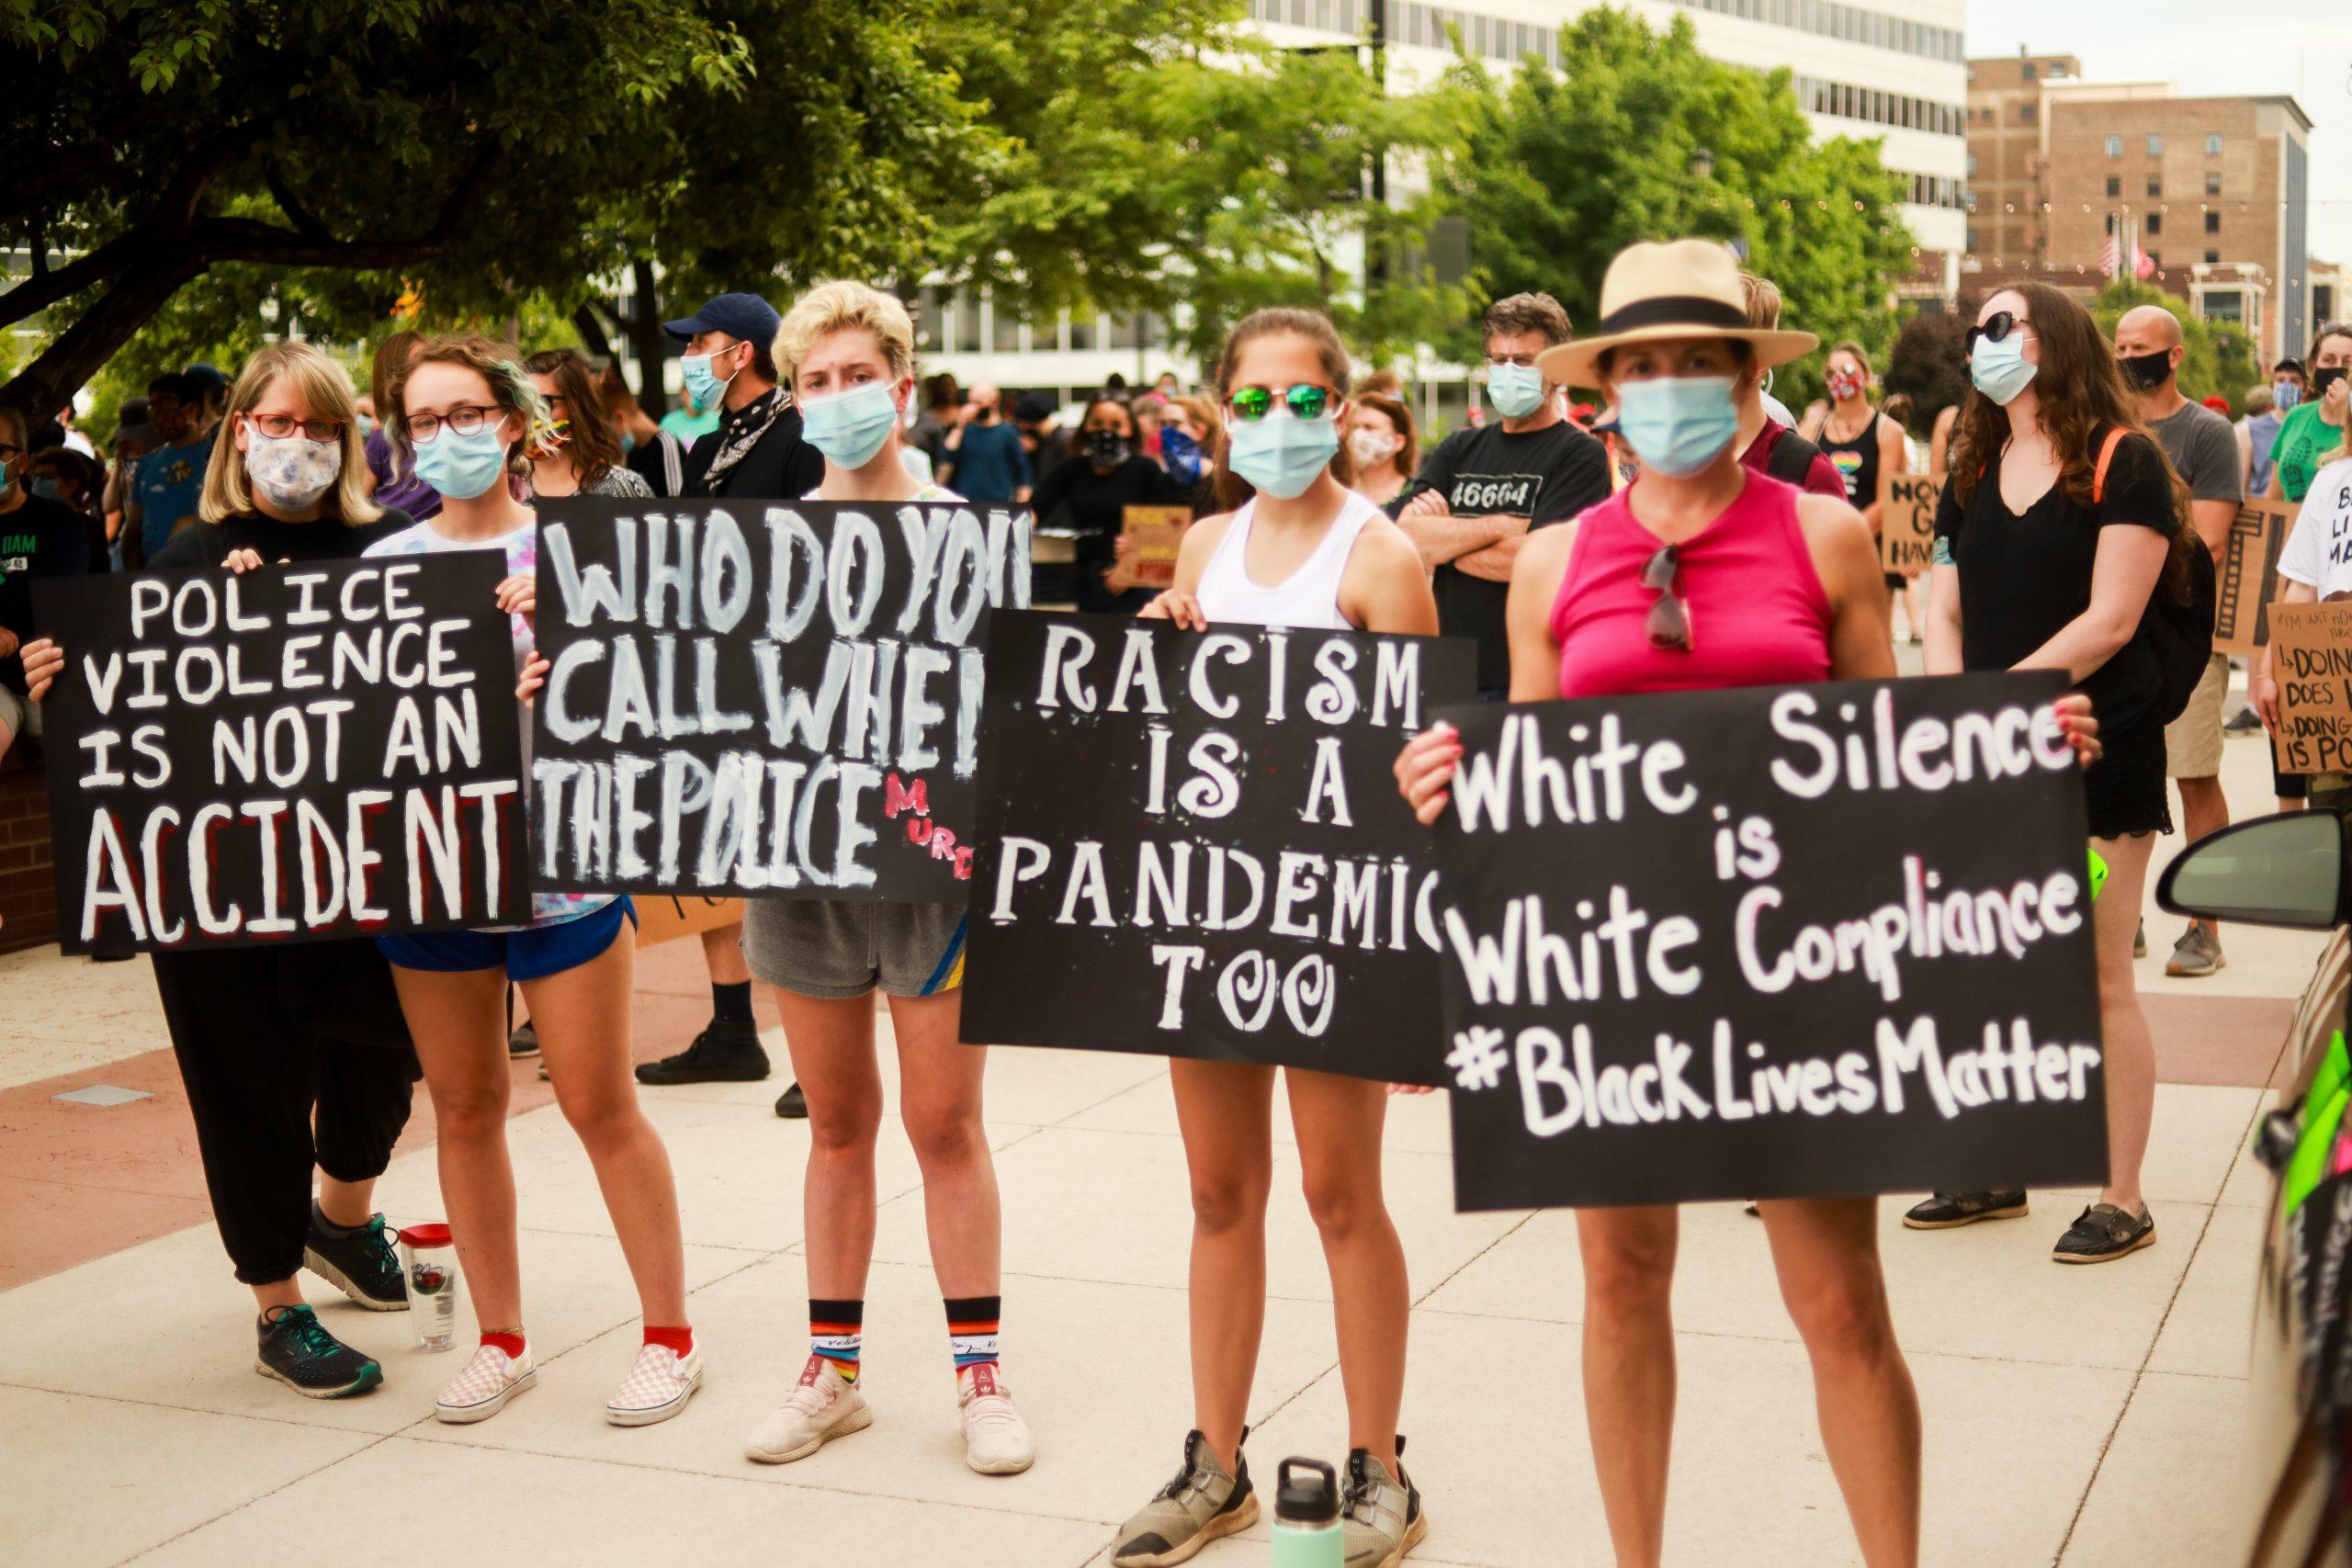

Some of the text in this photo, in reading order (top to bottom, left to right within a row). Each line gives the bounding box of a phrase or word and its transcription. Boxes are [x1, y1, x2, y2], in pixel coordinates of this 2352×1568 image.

[2338, 486, 2352, 509] B
[130, 564, 424, 638] POLICE
[543, 509, 753, 633] WHO
[764, 507, 885, 644] DO
[83, 619, 476, 715] VIOLENCE
[546, 626, 753, 744] CALL
[1035, 625, 1419, 730] RACISM
[2287, 682, 2334, 707] DOES
[79, 689, 481, 789] IS NOT AN
[1145, 727, 1352, 826] IS A
[1452, 688, 2076, 833] White Silence
[2287, 739, 2310, 770] IS
[81, 780, 518, 944] ACCIDENT
[533, 750, 885, 890] THE POLICE
[1713, 806, 1781, 879] is
[1443, 856, 2083, 1005] White Compliance
[1152, 945, 1334, 1037] TOO
